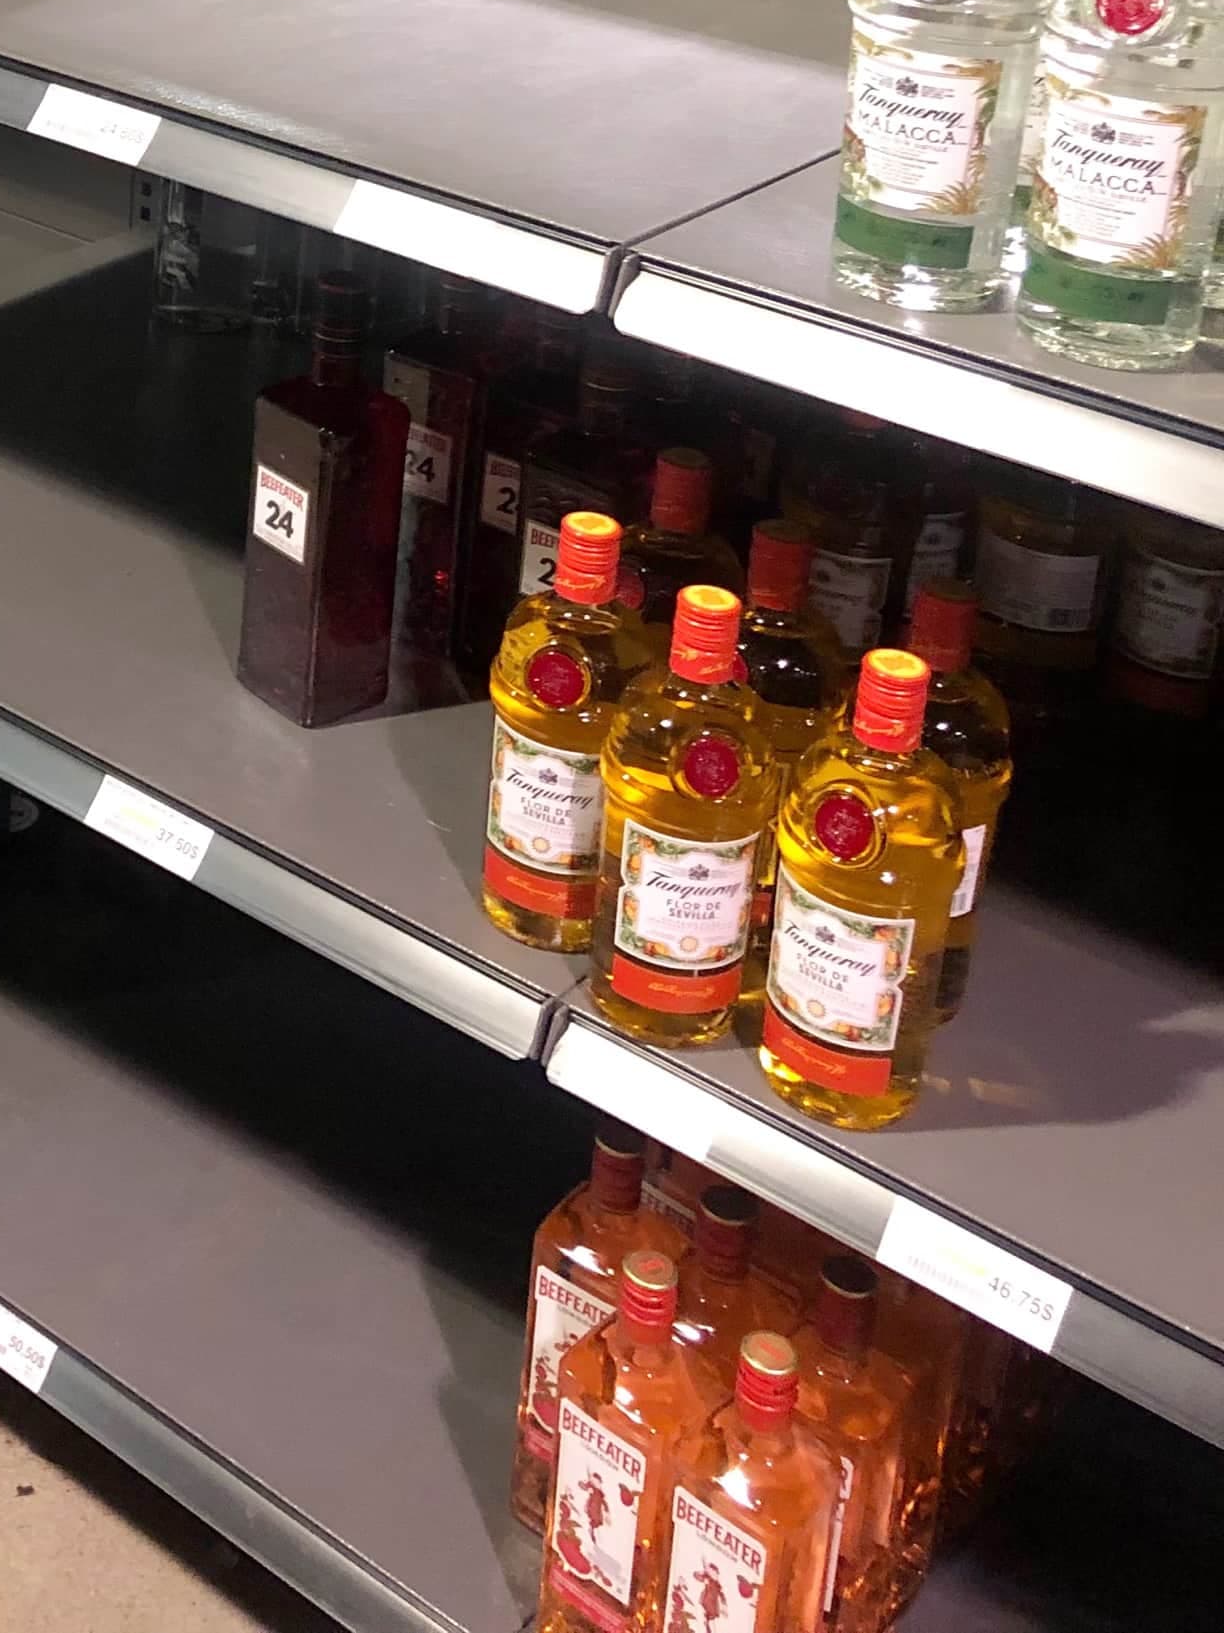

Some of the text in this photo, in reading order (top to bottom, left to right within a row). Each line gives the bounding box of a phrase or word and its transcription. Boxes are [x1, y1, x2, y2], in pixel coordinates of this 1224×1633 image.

[859, 82, 966, 129] Tanqueray
[1051, 128, 1166, 178] Tanqueray
[261, 471, 305, 513] BEEFEATER
[495, 486, 521, 515] 2
[265, 499, 294, 539] 24
[538, 557, 557, 587] 2
[506, 767, 593, 810] Tanqueray
[520, 796, 573, 819] FLOR DE
[522, 805, 566, 826] SEVILLA
[646, 870, 743, 900] Tanqueray
[666, 898, 721, 911] FLOR DE
[669, 908, 716, 920] SEVILLA
[784, 919, 877, 977] Tanqueray
[799, 962, 843, 993] SEVILLA
[562, 1407, 641, 1485] BEEFEATER
[676, 1495, 762, 1576] BEEFEATER
